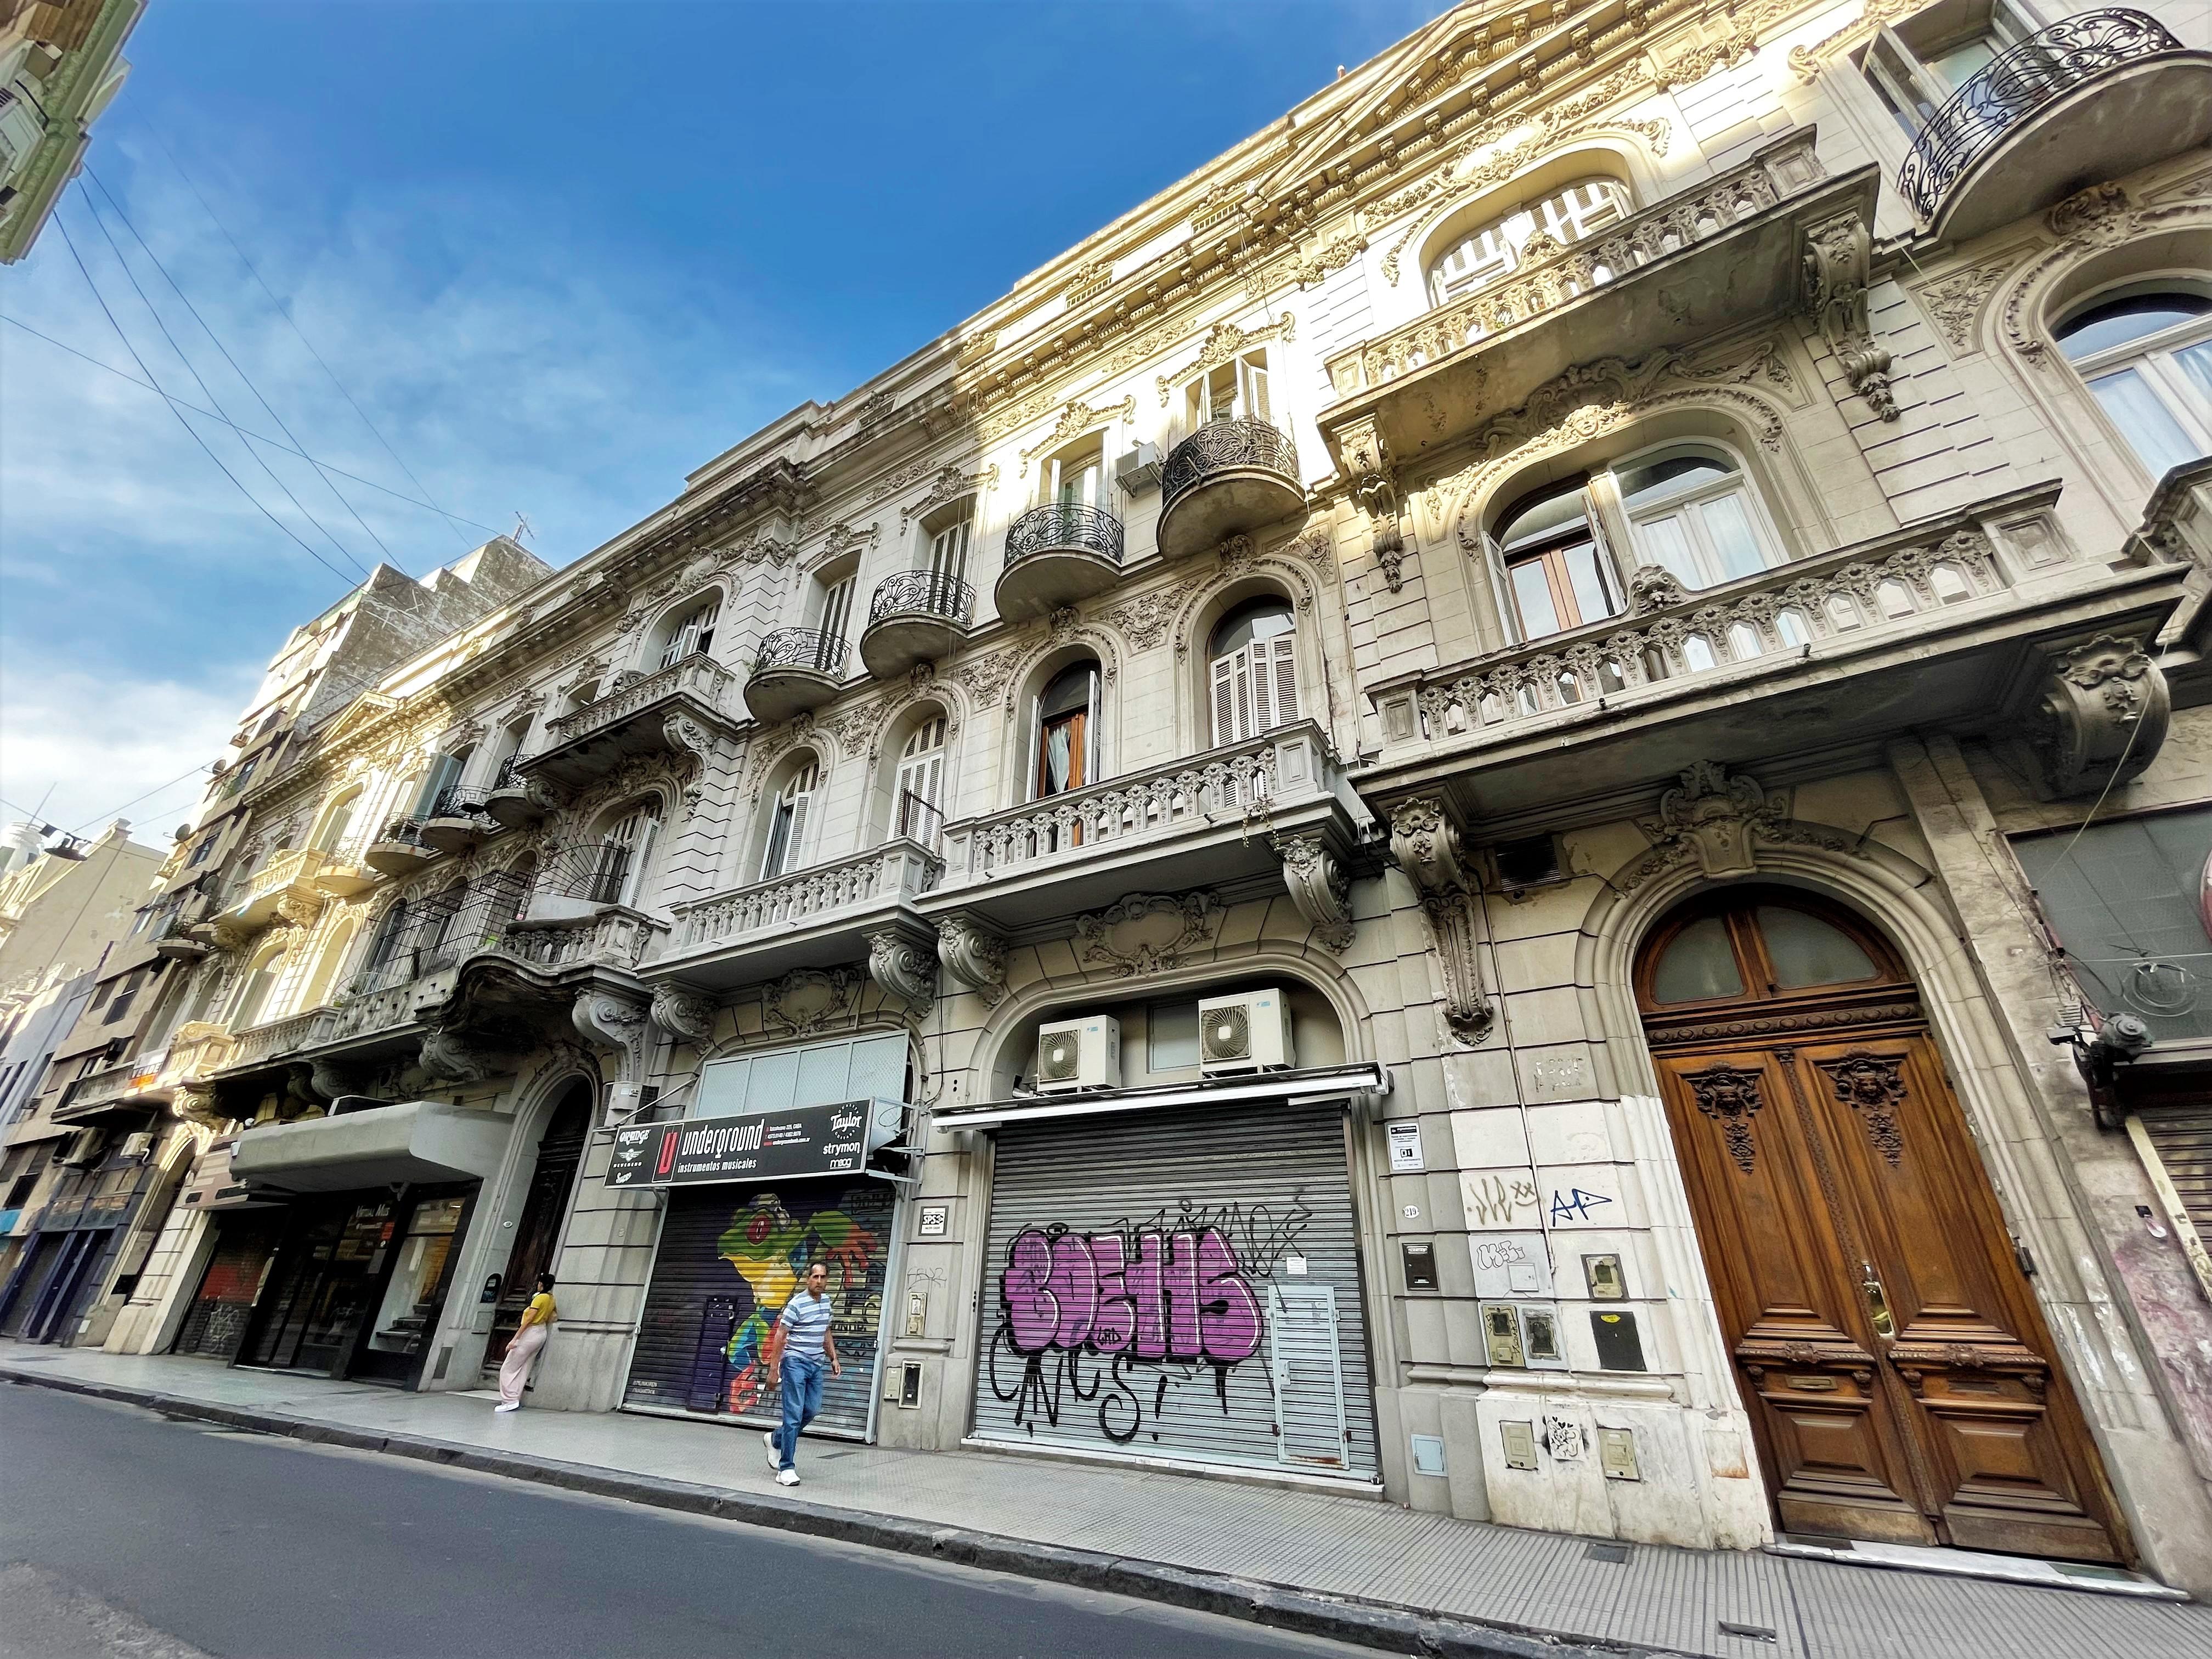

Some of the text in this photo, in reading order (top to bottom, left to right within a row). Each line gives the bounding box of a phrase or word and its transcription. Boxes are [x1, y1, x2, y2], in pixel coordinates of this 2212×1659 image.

[831, 1111, 862, 1132] Taylor
[822, 1142, 861, 1156] strymon
[678, 1158, 757, 1173] instrumentos musicales
[830, 1158, 853, 1170] moog
[1405, 1207, 1417, 1216] 219
[922, 1215, 936, 1224] SPS
